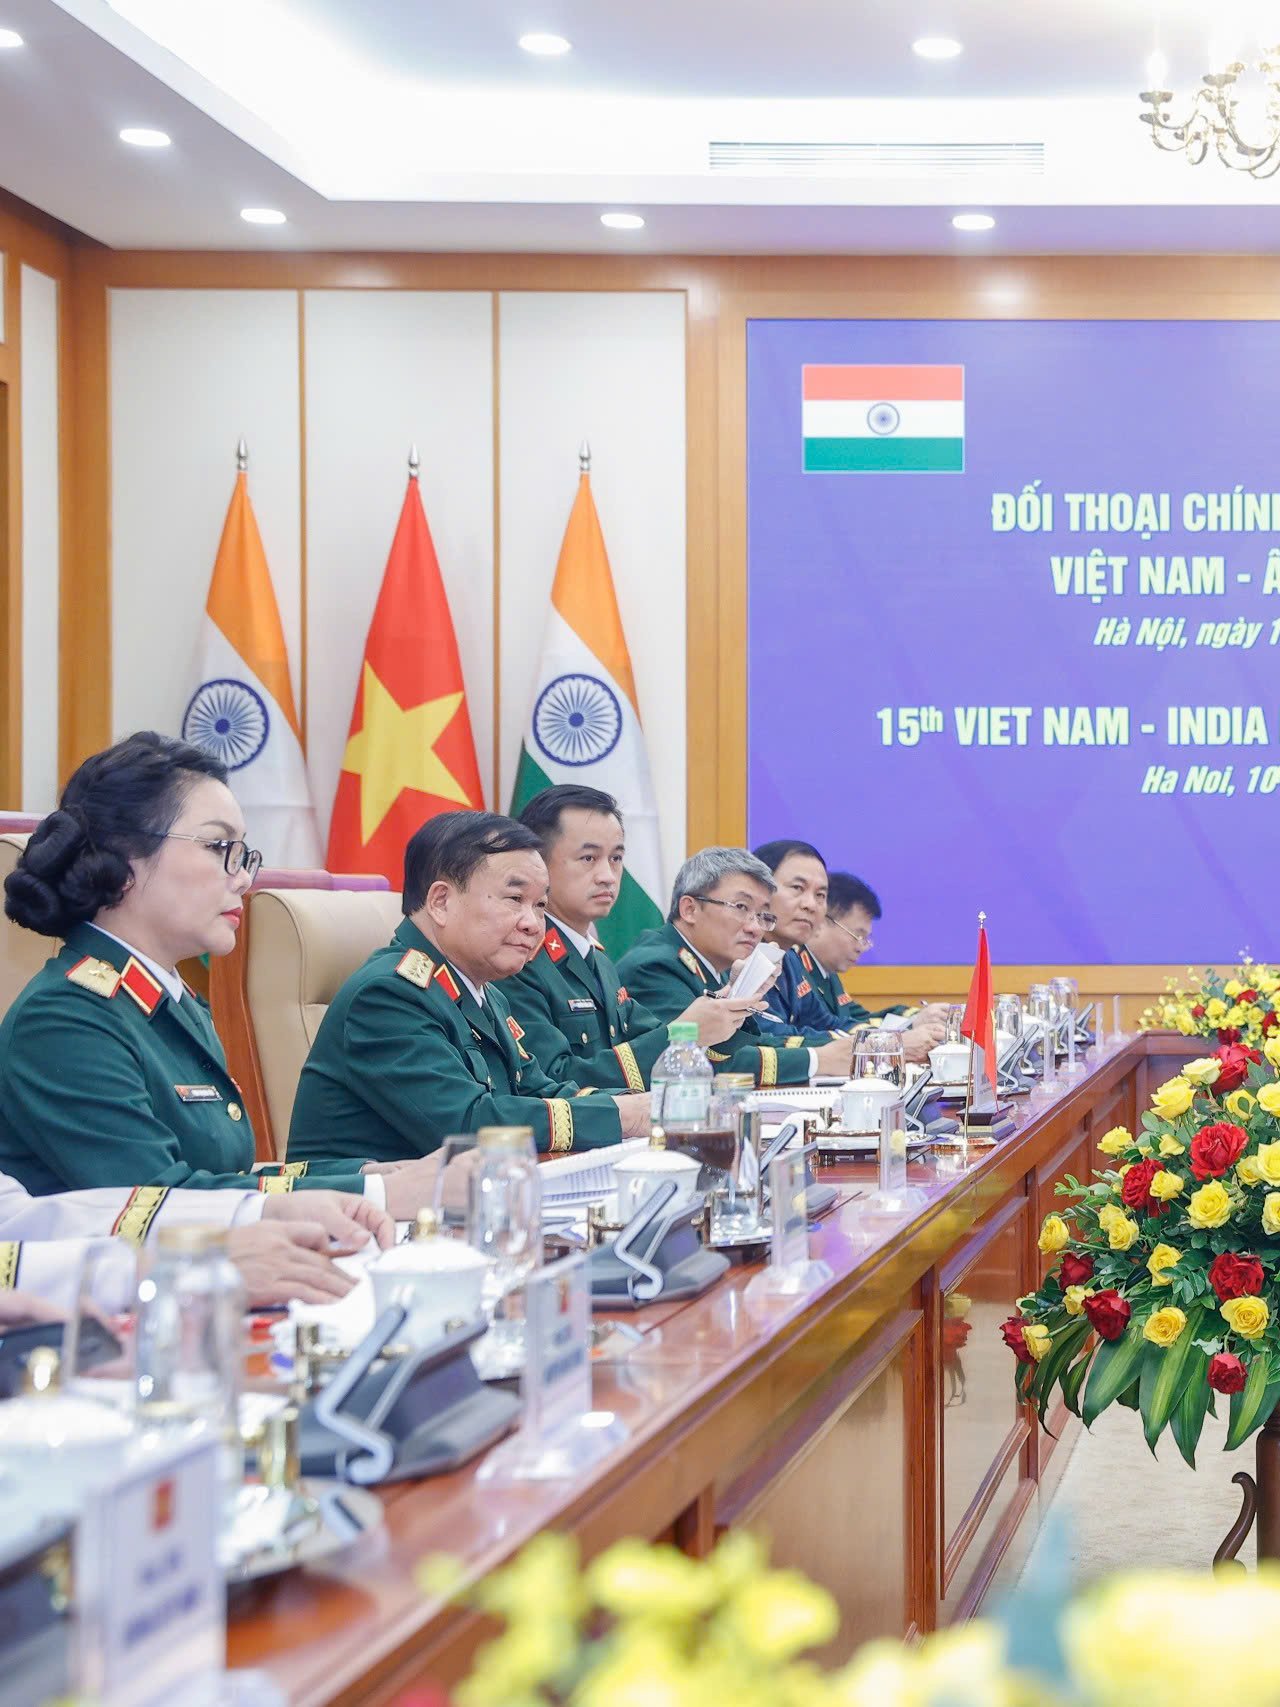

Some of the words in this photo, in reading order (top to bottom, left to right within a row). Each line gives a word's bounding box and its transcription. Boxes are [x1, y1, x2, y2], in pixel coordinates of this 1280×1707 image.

[991, 479, 1053, 532] ĐỐI
[1064, 492, 1170, 540] THOẠI
[1050, 547, 1129, 604] VIỆT
[1139, 556, 1225, 595] NAM
[1093, 617, 1132, 646] Hà
[1135, 617, 1188, 652] Nội,
[1194, 616, 1264, 650] ngày
[876, 706, 944, 746] 15th
[954, 706, 1033, 746] VIET
[1043, 706, 1129, 746] NAM
[1167, 706, 1269, 746] INDIA
[1140, 766, 1179, 794] Ha
[1182, 765, 1236, 798] Noi,
